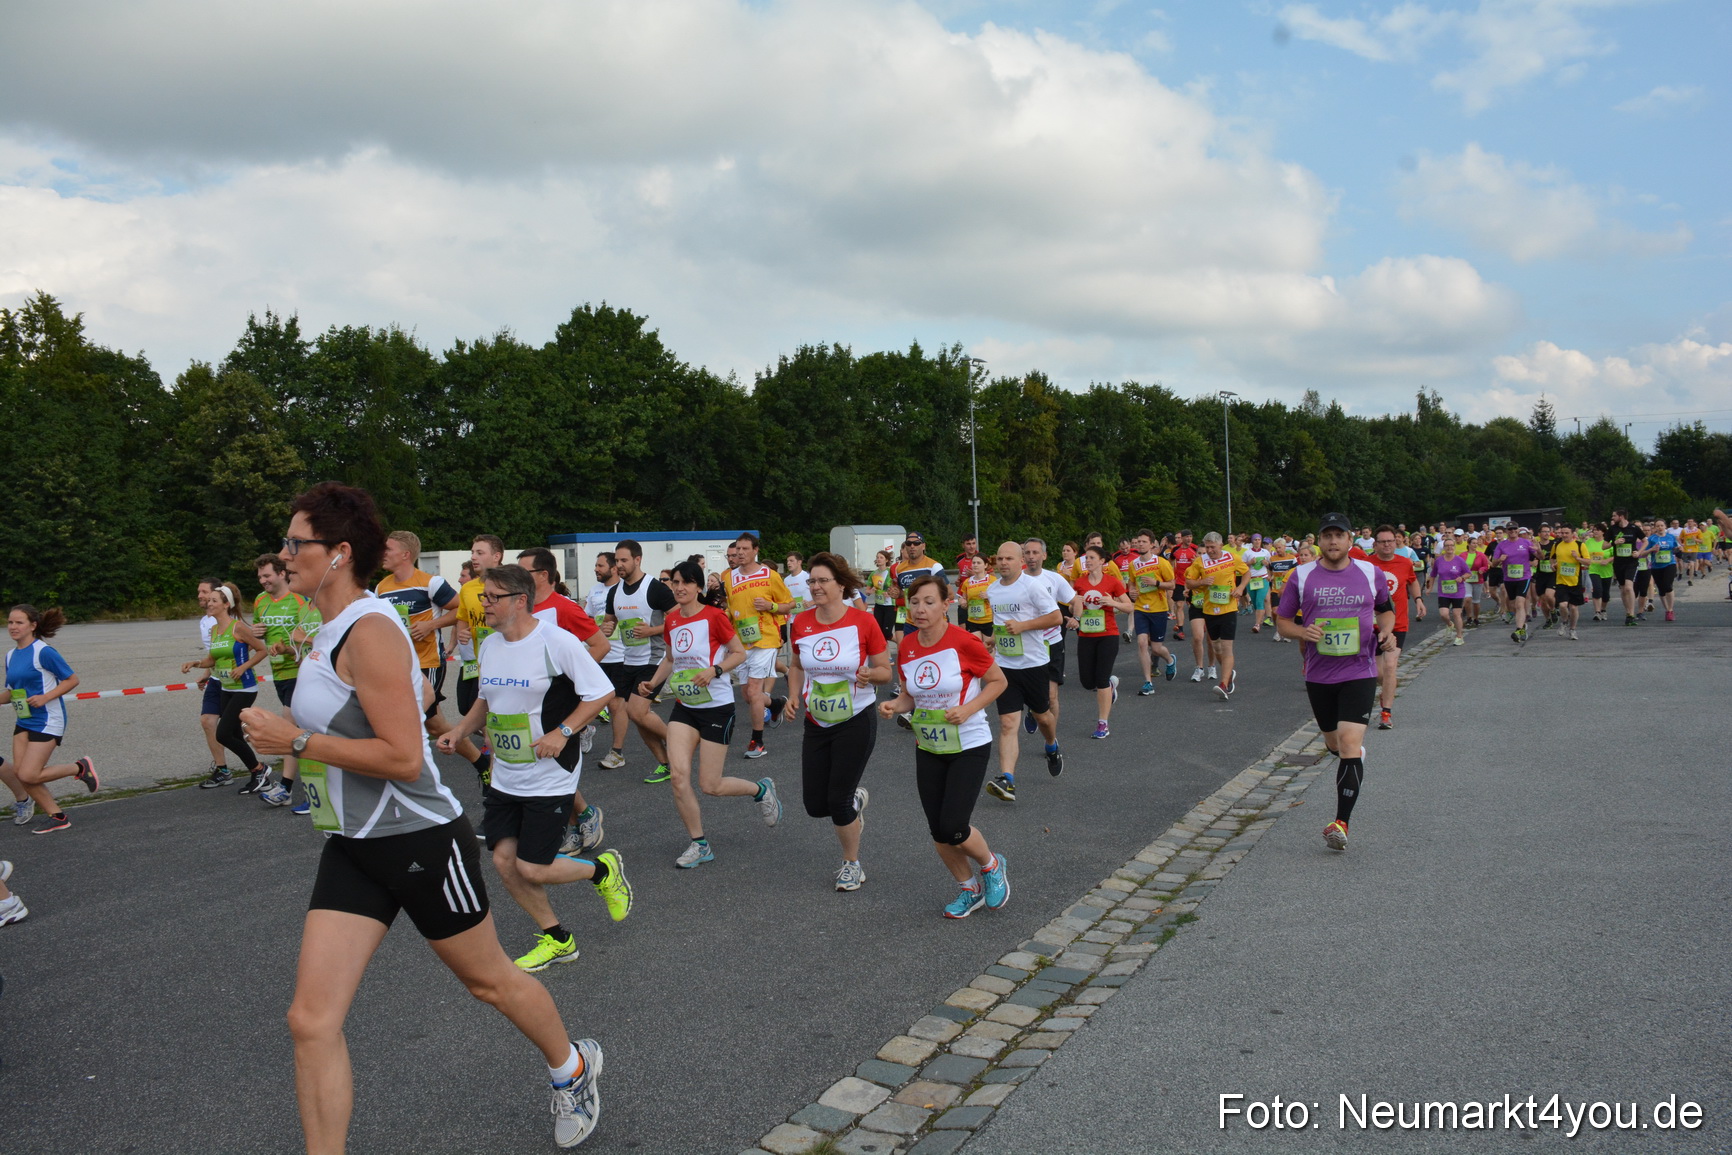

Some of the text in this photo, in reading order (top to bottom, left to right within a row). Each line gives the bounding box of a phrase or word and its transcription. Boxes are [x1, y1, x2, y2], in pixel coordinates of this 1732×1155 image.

[732, 584, 748, 596] MAX
[1314, 587, 1346, 596] HECK
[1318, 595, 1364, 606] DESIGN
[1084, 618, 1100, 626] 496
[742, 626, 756, 637] 853
[998, 638, 1016, 648] 488
[1324, 633, 1350, 646] 517
[481, 678, 530, 687] DELPHI
[678, 684, 700, 696] 538
[812, 698, 848, 712] 1674
[920, 728, 948, 742] 541
[494, 734, 521, 750] 280
